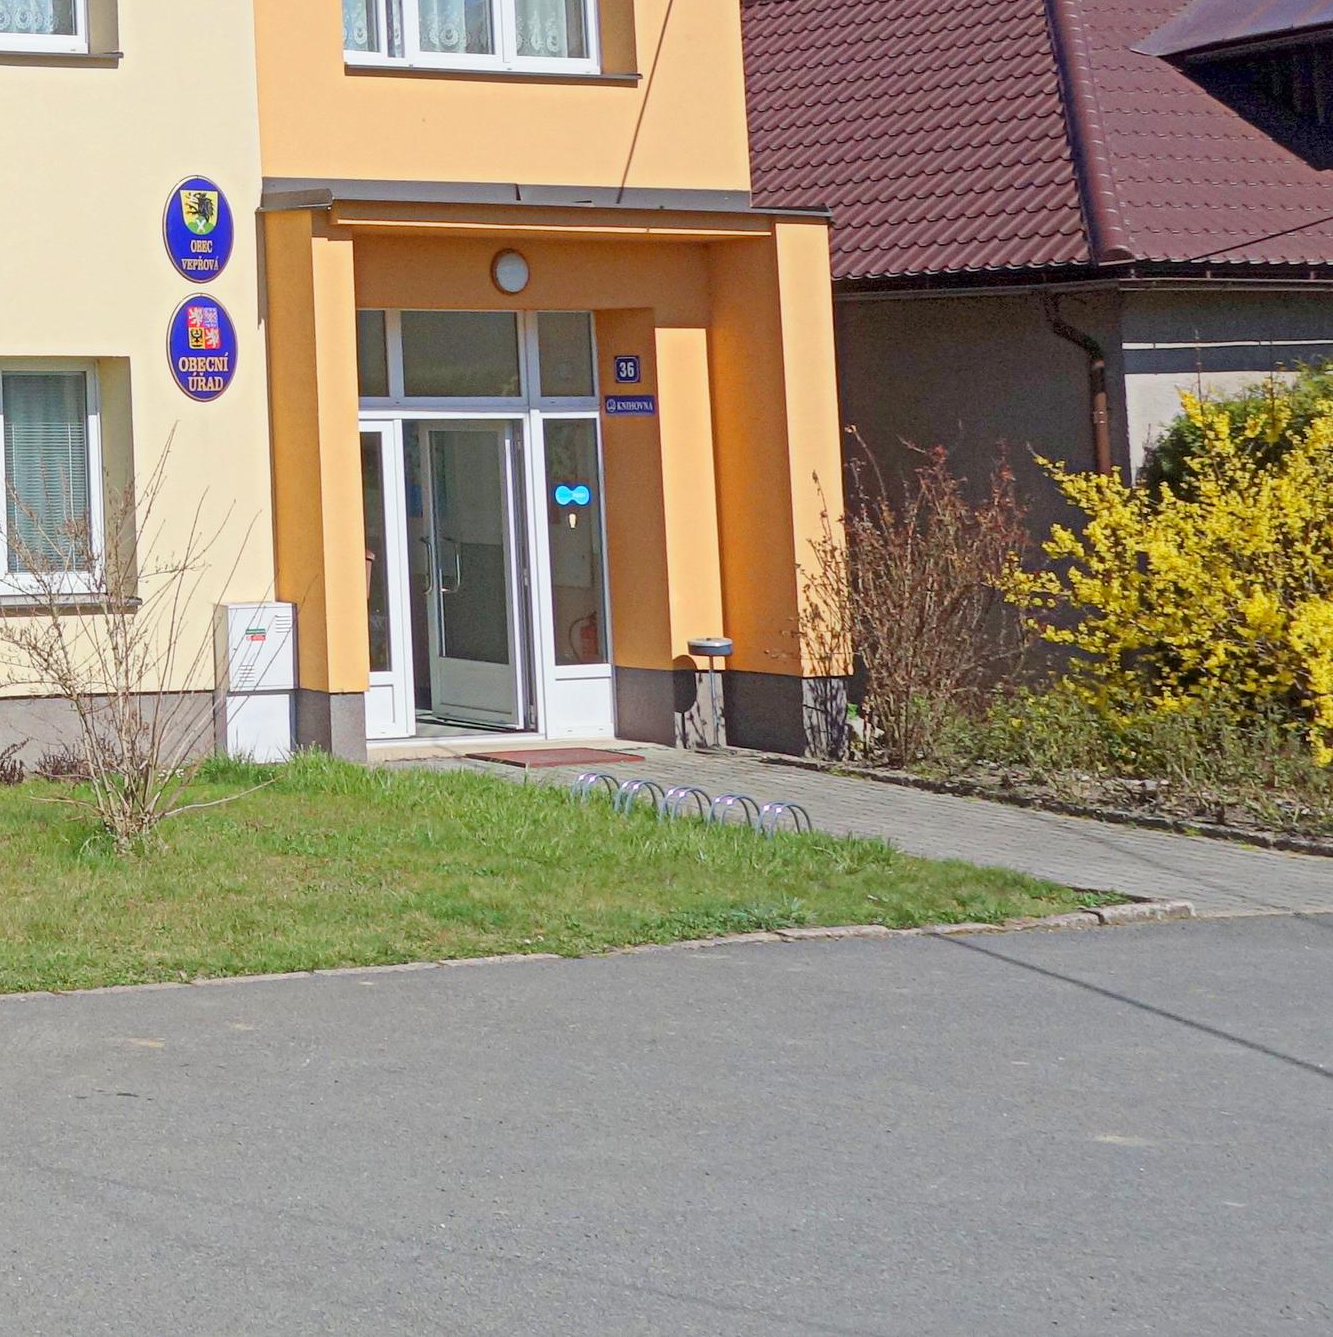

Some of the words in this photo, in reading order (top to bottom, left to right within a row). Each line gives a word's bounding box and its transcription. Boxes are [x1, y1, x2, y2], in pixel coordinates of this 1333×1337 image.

[190, 239, 213, 253] OBEC
[181, 255, 219, 271] VEPŘOVÁ
[178, 351, 229, 372] OBECNÍ
[619, 361, 635, 378] 36
[187, 371, 224, 392] ÚŘAD
[616, 401, 653, 411] KNIHOVNA
